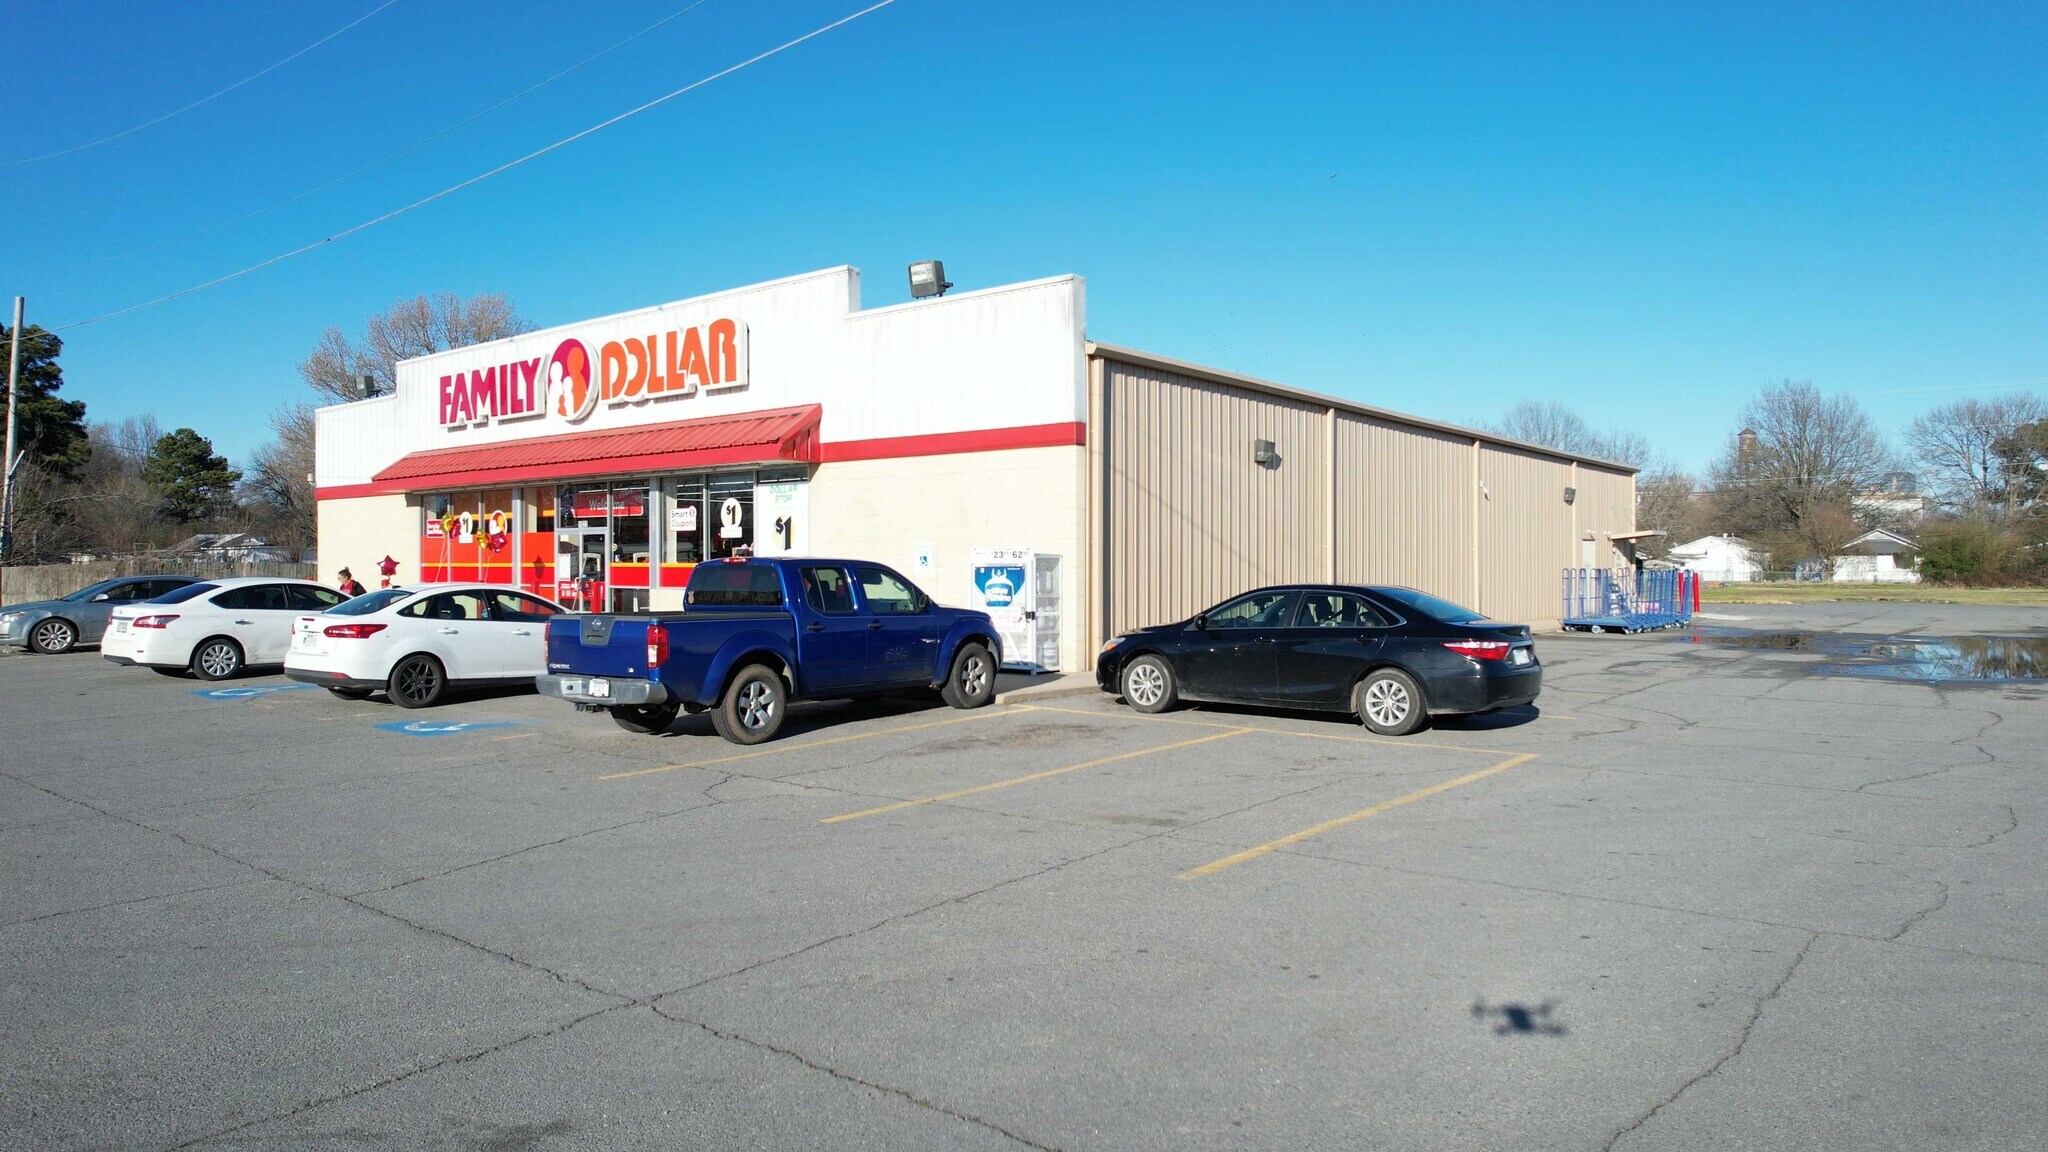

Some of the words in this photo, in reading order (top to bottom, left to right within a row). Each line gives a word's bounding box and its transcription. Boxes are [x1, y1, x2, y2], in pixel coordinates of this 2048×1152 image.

[440, 357, 541, 424] FAMILY
[601, 318, 736, 399] DOLLAR
[589, 498, 625, 511] Welcme
[671, 510, 688, 518] Smart
[726, 504, 736, 525] $1
[774, 515, 793, 551] $1
